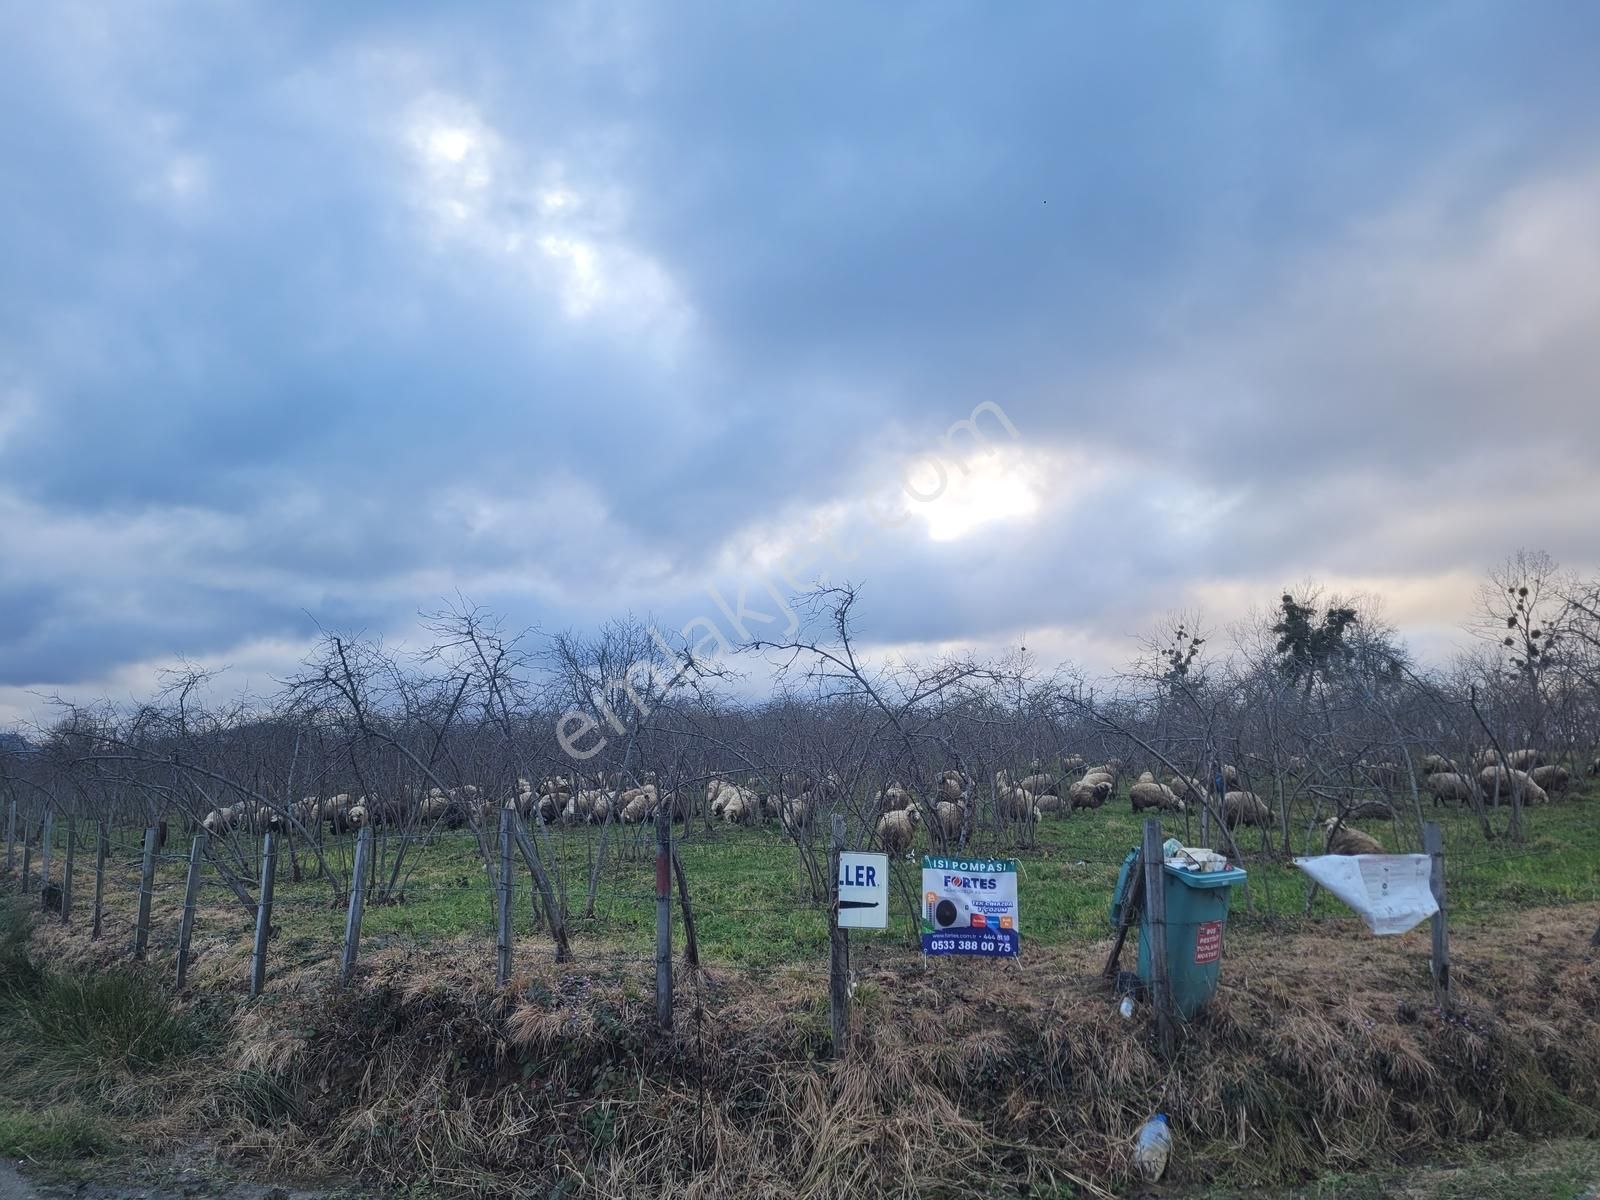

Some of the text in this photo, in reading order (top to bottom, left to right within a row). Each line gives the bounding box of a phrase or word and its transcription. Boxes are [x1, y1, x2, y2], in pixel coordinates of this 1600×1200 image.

[933, 860, 1007, 872] ISI POMPASI
[944, 875, 997, 889] FORTES
[983, 933, 996, 941] 444
[931, 940, 1011, 952] 0533 388 00 75
